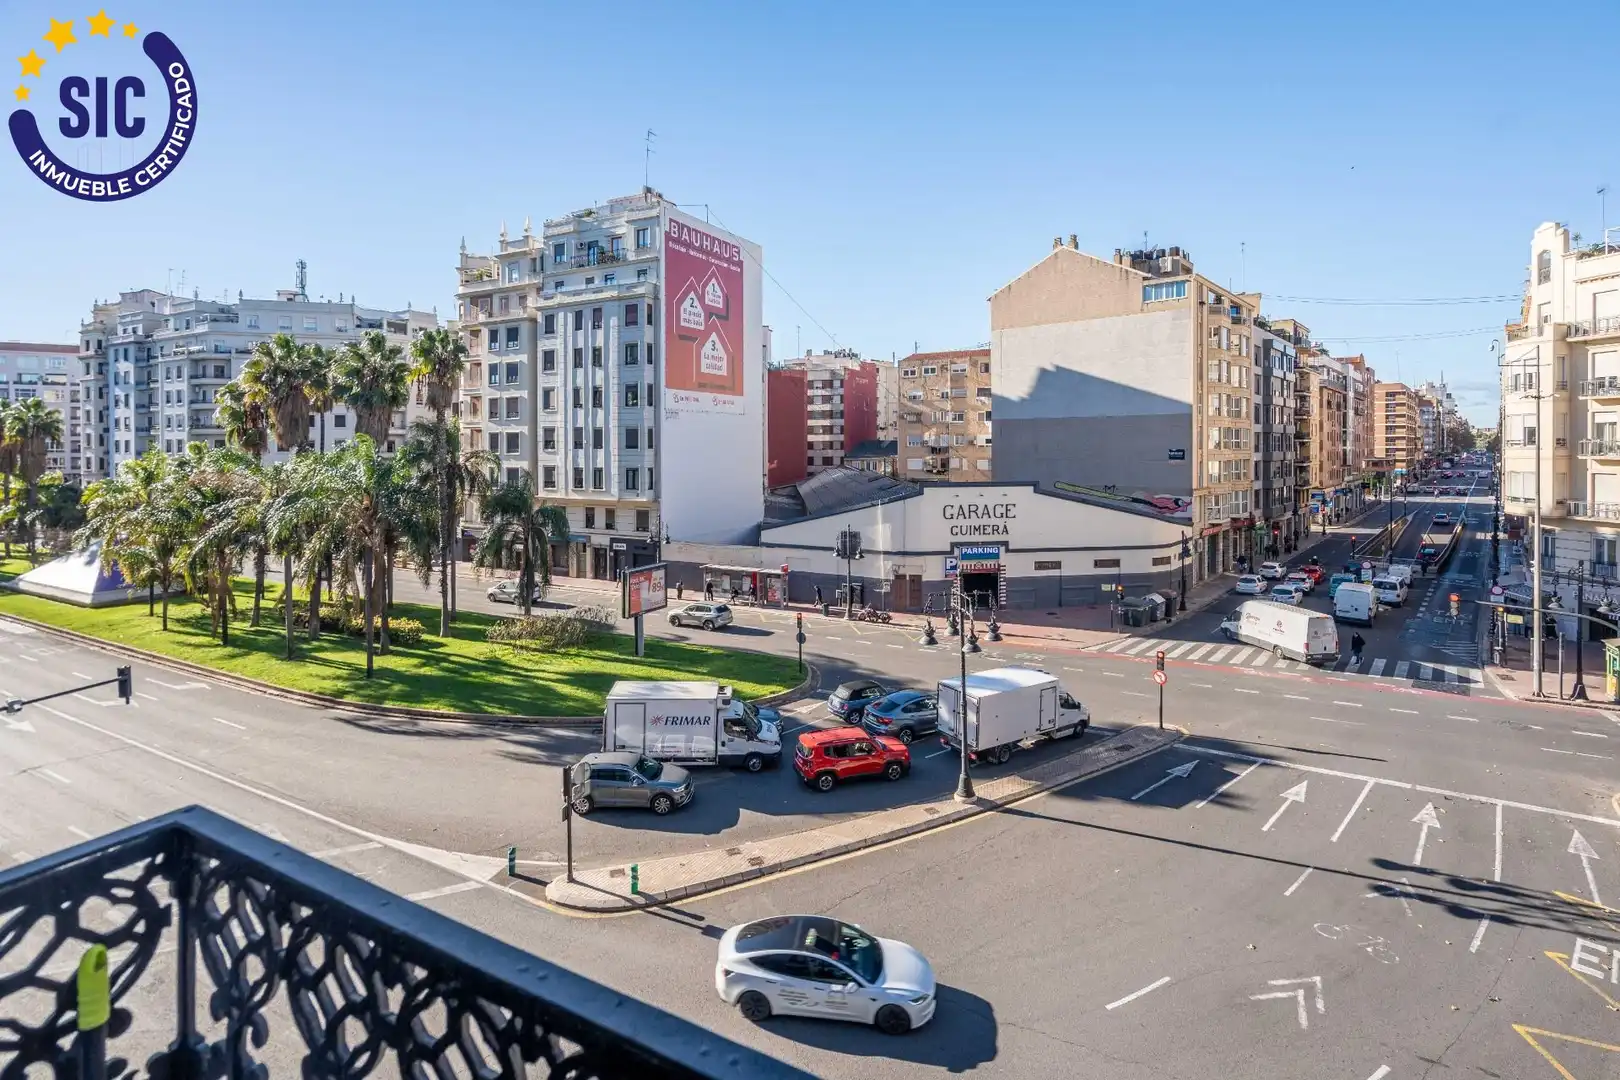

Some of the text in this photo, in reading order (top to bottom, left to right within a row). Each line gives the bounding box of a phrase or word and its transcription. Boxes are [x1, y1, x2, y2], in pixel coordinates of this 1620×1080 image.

[670, 221, 740, 261] BAUHAUS
[943, 503, 1017, 520] GARAGE
[950, 520, 1010, 536] GUIMERÁ
[946, 558, 957, 570] P
[664, 715, 711, 727] FRIMAR
